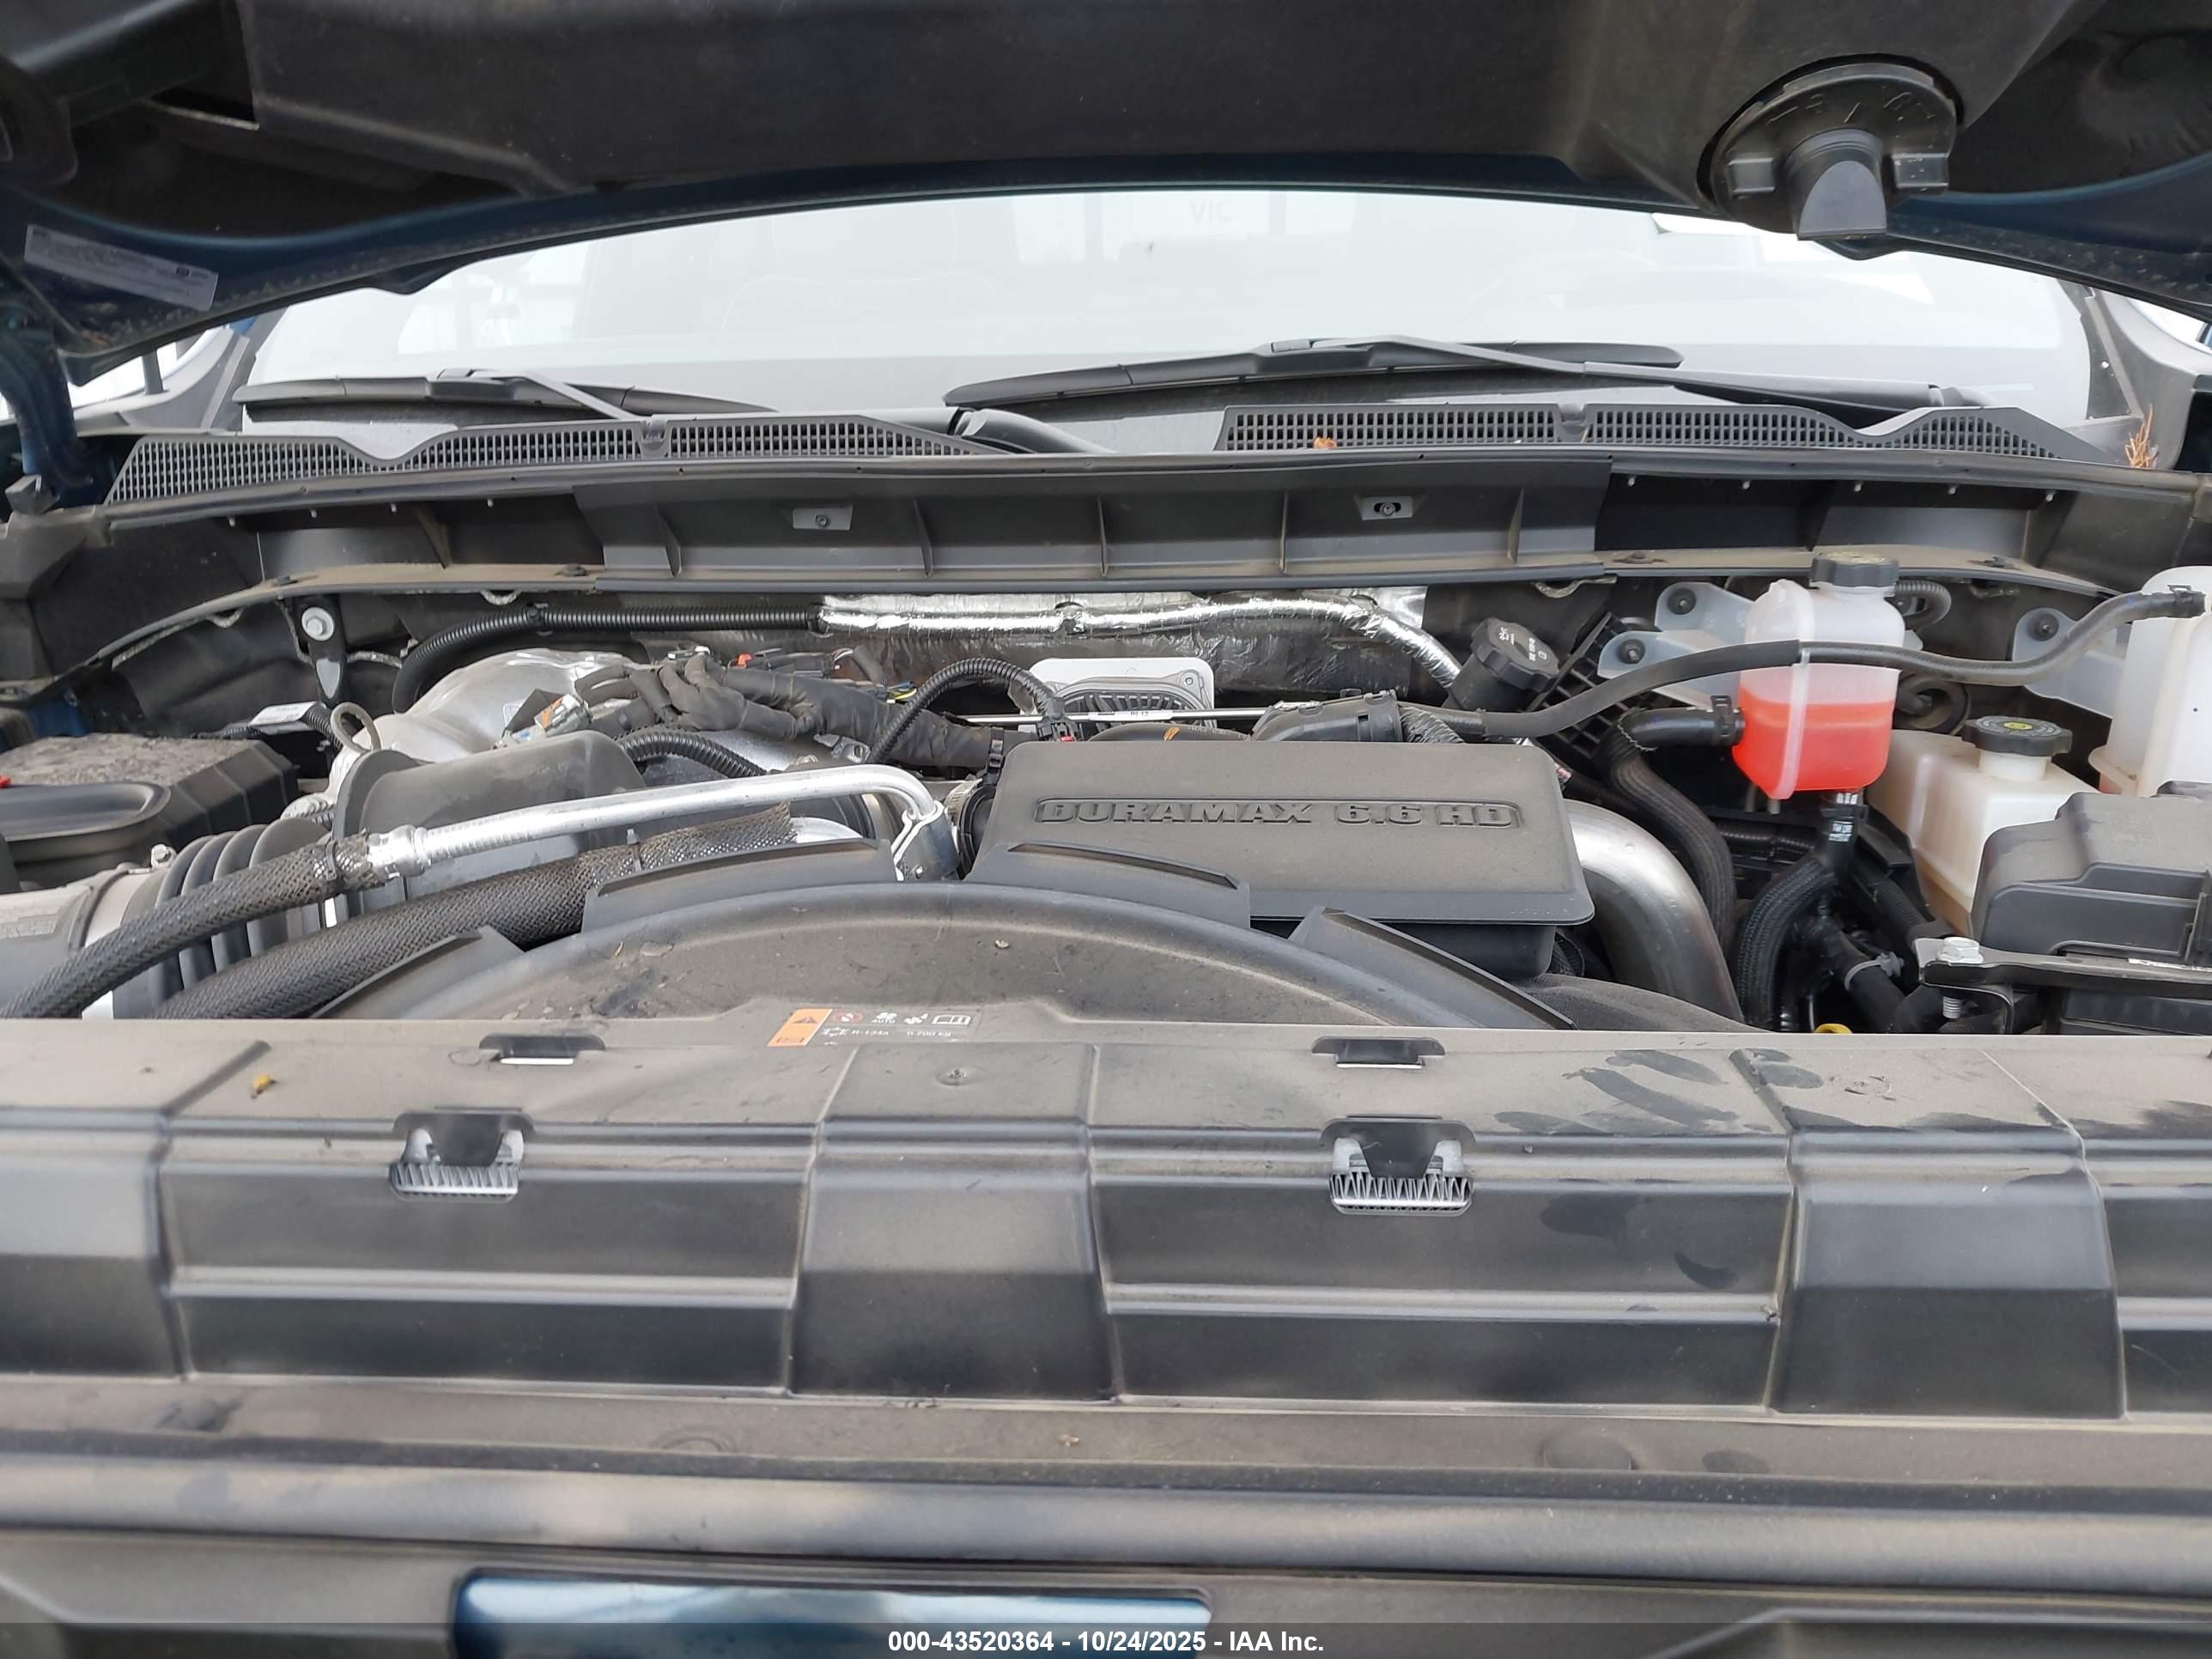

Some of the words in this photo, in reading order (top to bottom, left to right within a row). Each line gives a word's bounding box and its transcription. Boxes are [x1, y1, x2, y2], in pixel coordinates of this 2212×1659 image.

[1035, 803, 1312, 824] DURAMAX
[1334, 803, 1422, 825] 6.6
[1436, 805, 1517, 827] HD
